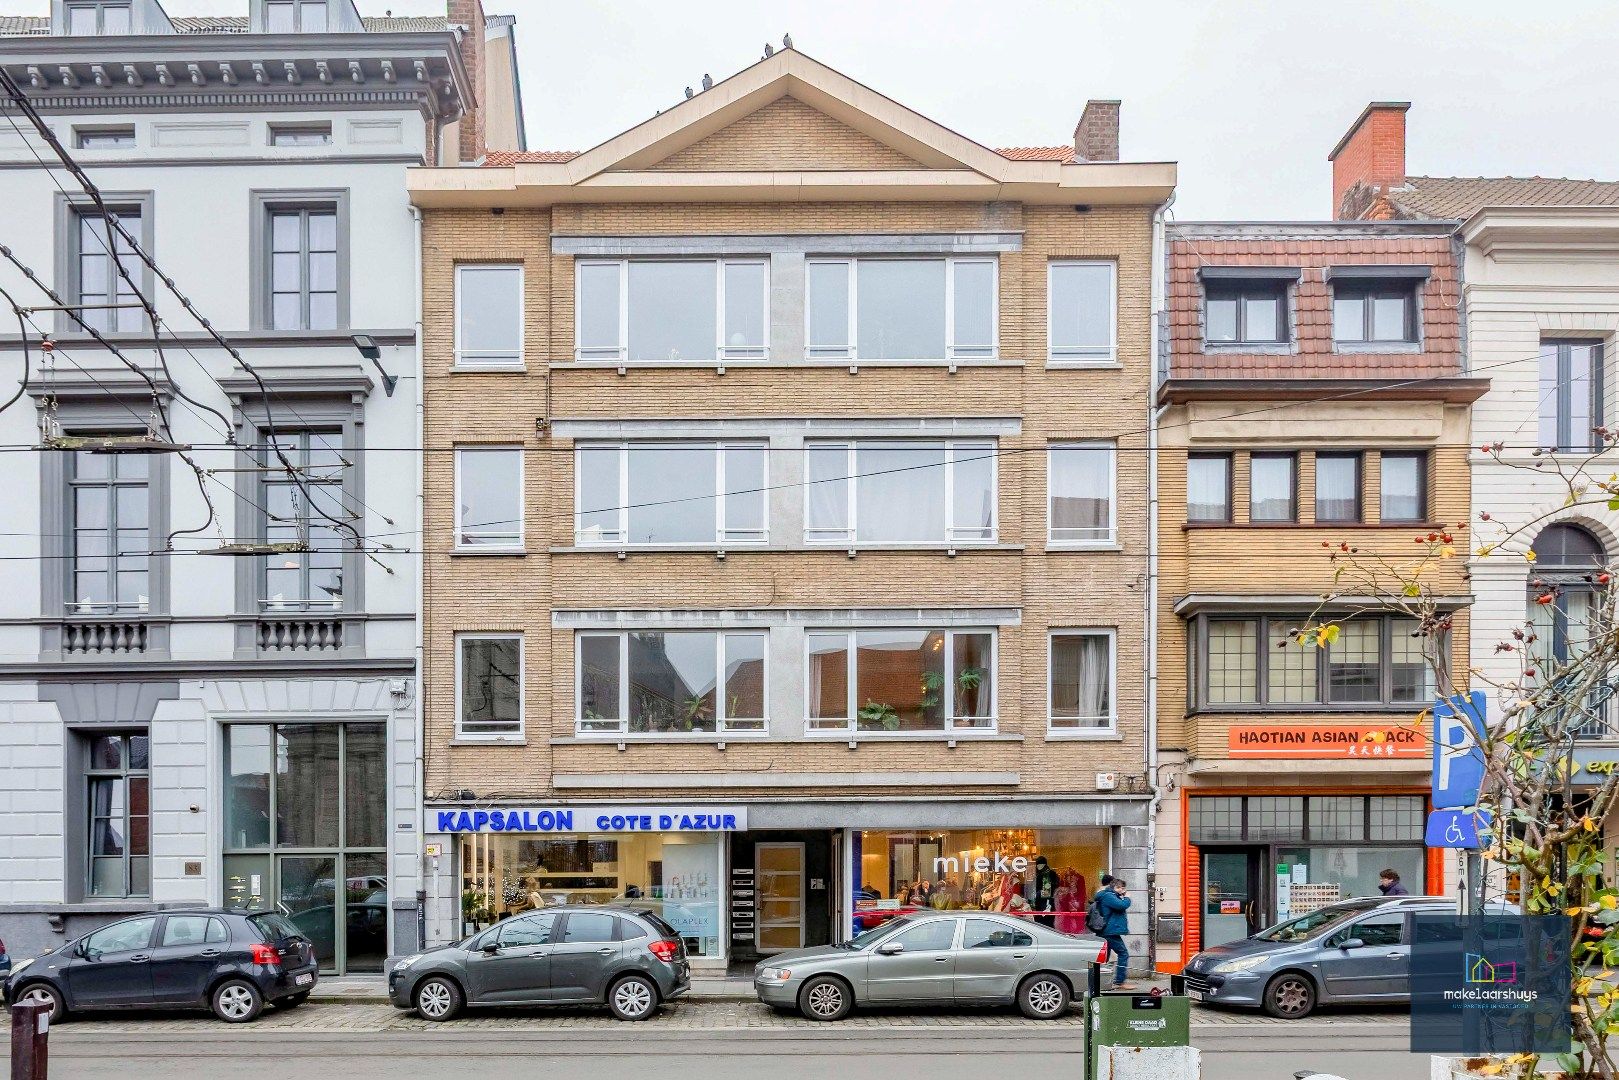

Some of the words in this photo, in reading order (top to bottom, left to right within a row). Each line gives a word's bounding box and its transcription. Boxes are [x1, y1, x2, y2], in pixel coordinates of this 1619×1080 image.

[1239, 731, 1306, 744] HAOTIAN
[1311, 731, 1359, 744] ASIAN
[1438, 713, 1475, 791] P
[437, 810, 573, 831] KAPSALON
[596, 815, 652, 830] COTE
[933, 851, 1028, 873] mieke
